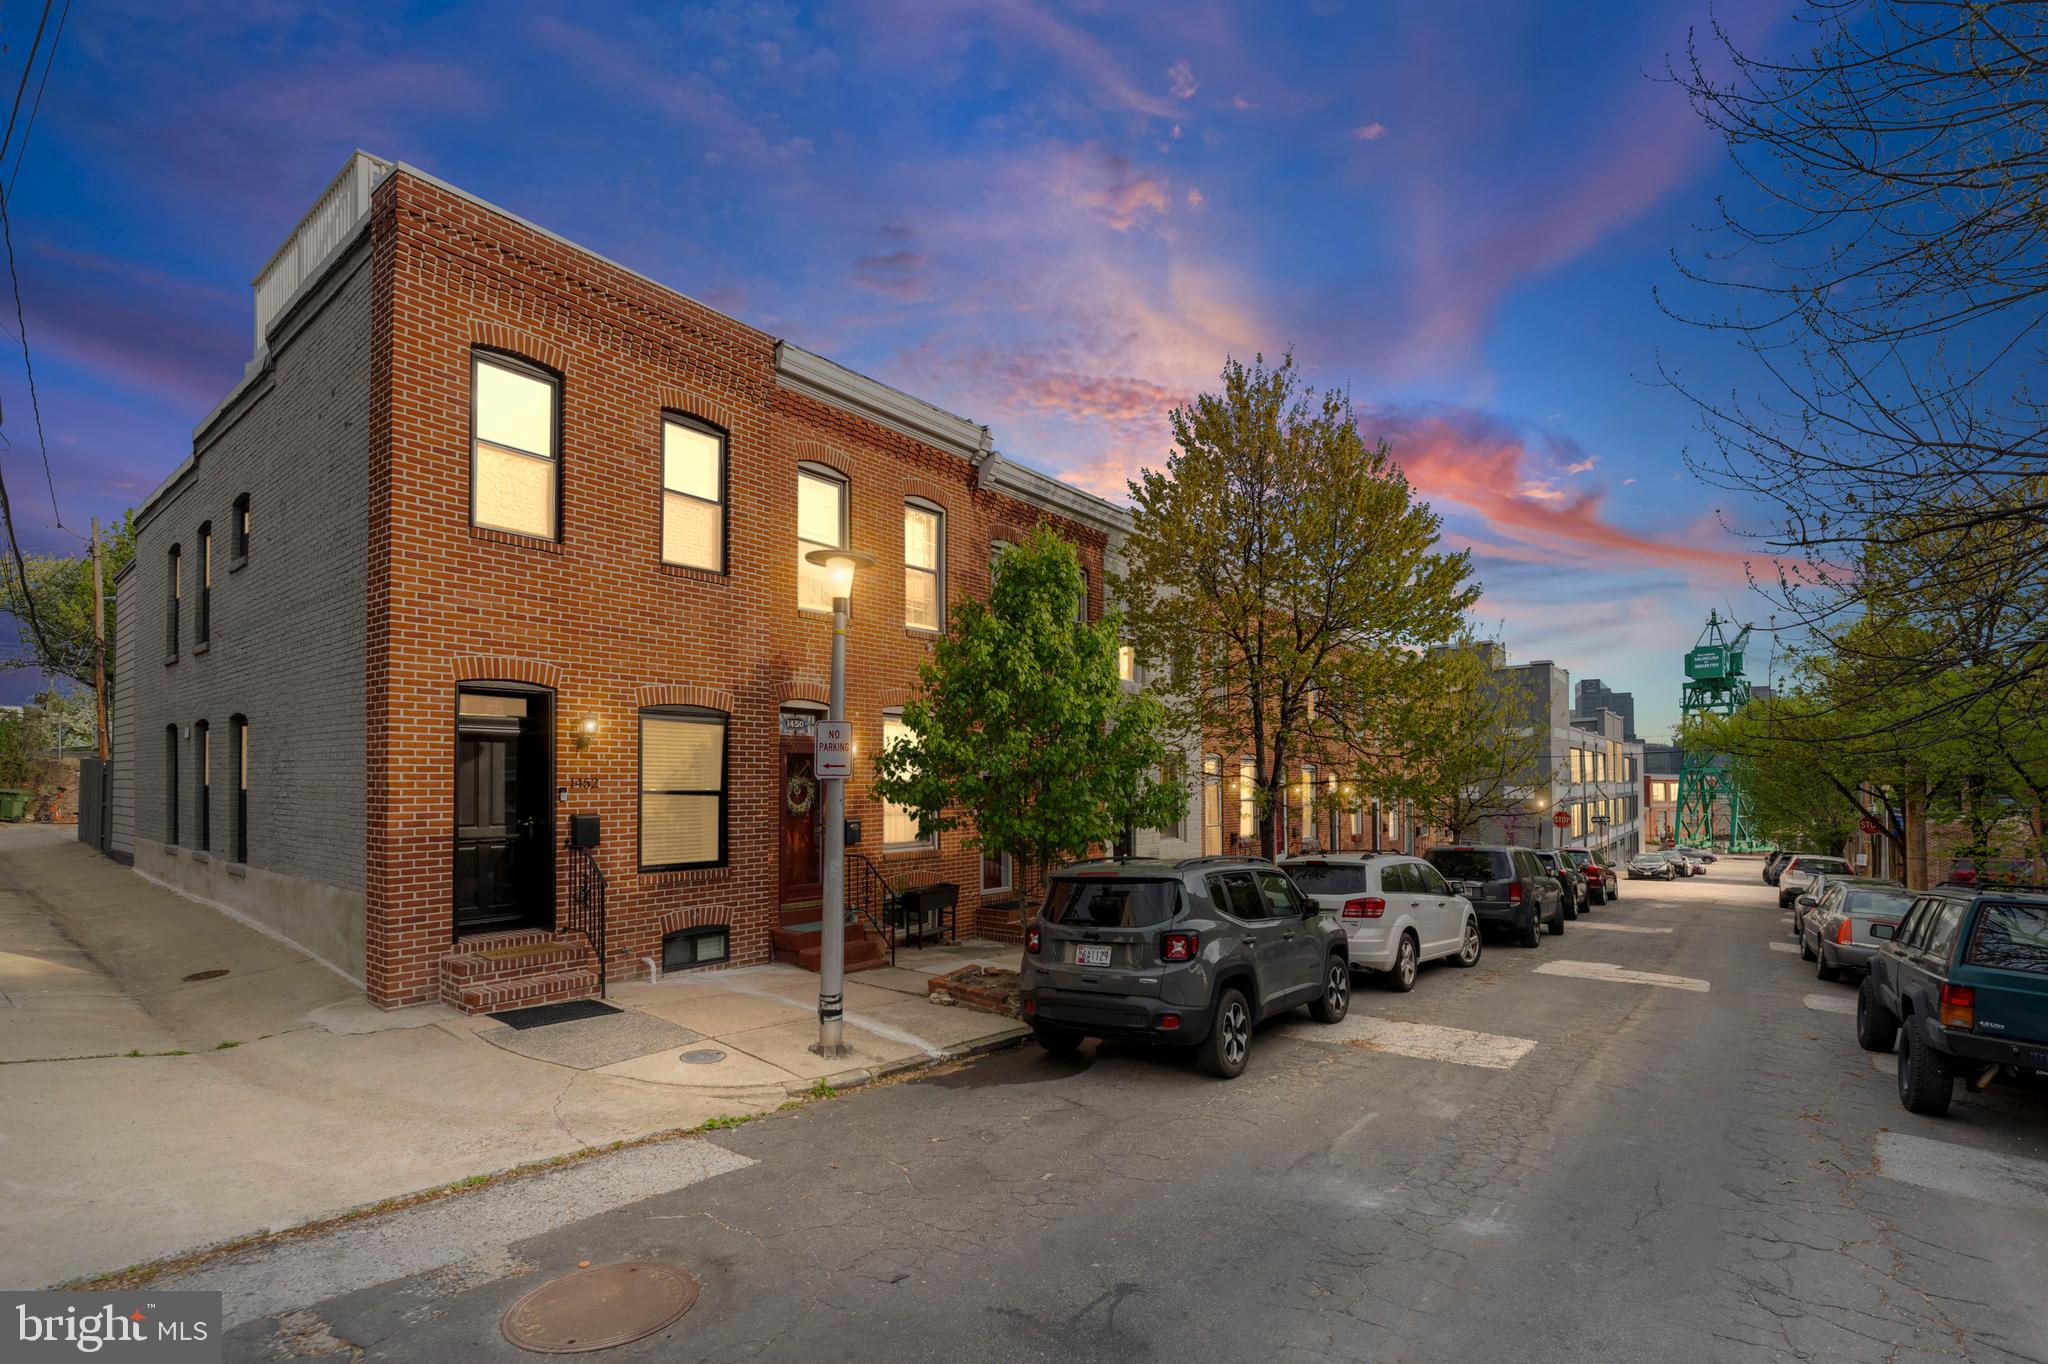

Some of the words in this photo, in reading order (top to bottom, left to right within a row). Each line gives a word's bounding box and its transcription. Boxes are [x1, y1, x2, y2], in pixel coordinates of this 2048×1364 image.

[786, 720, 804, 728] 1450
[828, 730, 841, 739] NO
[819, 742, 850, 752] PARKING
[569, 777, 599, 789] 1452
[1553, 815, 1571, 824] STOP
